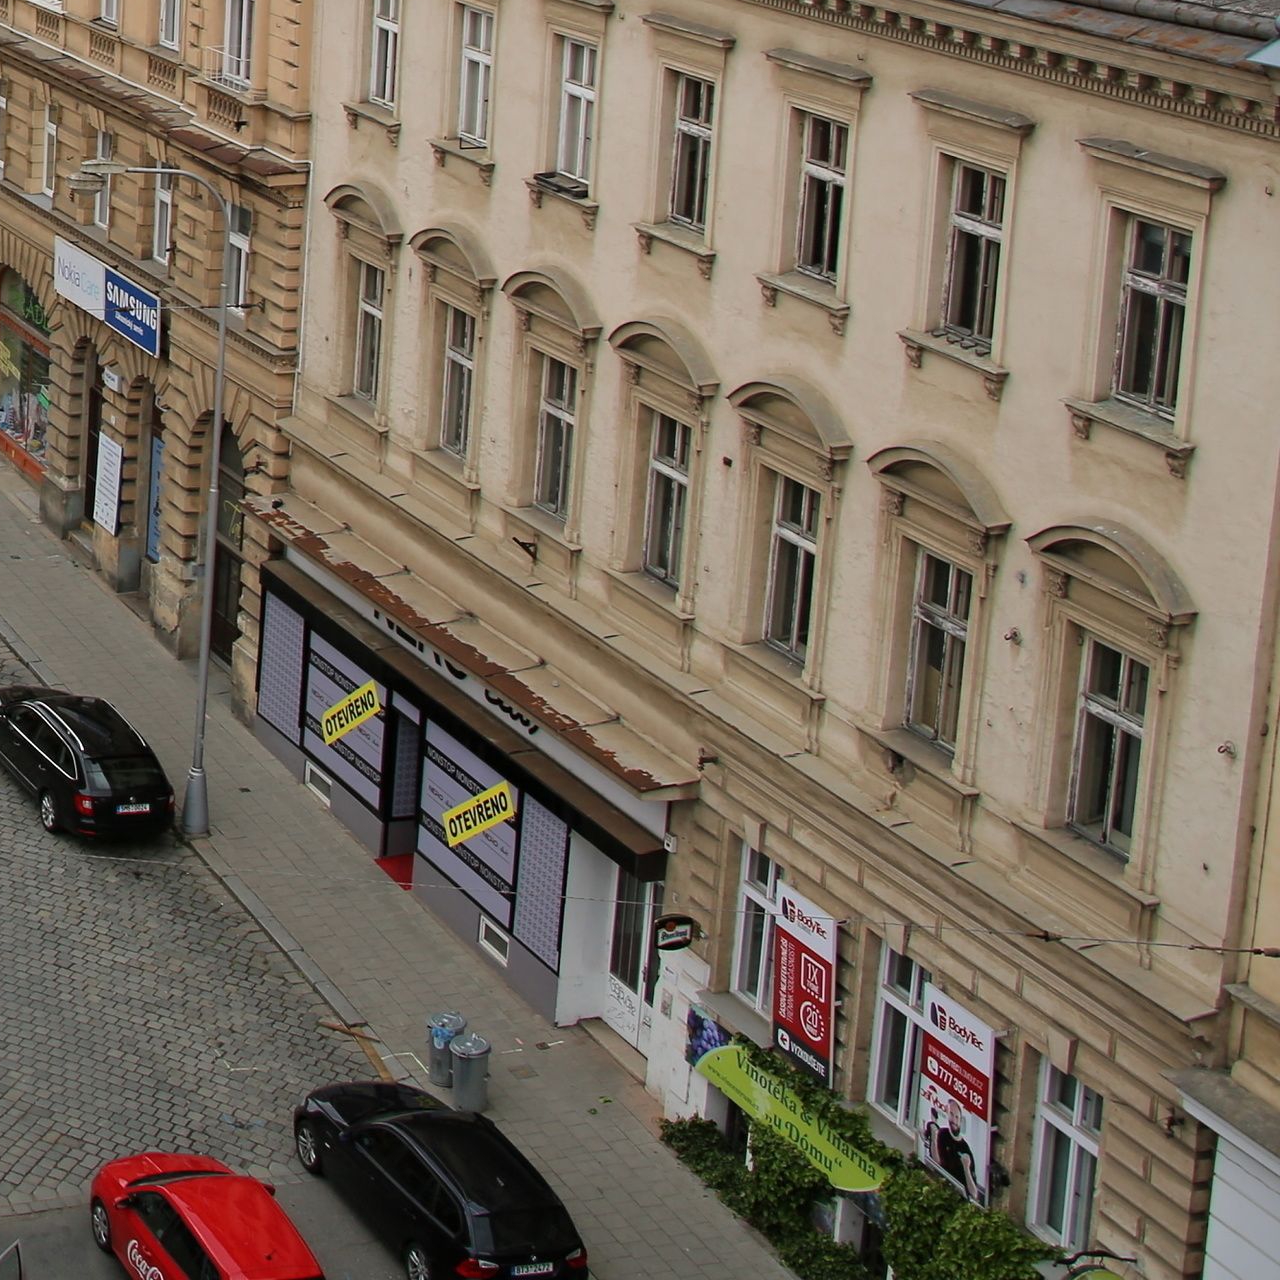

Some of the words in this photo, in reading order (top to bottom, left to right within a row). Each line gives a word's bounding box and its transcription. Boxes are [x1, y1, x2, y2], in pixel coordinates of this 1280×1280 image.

[58, 256, 80, 287] Nokia
[81, 272, 100, 300] Care
[106, 281, 157, 330] SAMSUNG
[325, 689, 375, 736] OTEVŘENO
[427, 745, 456, 774] NONSTOP
[448, 791, 508, 838] OTEVŘENO
[797, 907, 827, 940] BodyTec
[807, 963, 818, 985] 1X
[806, 1006, 818, 1028] 20
[948, 1015, 984, 1052] BodyTec
[736, 1051, 797, 1113] Vinotéka
[800, 1111, 812, 1126] &
[939, 1065, 952, 1086] 777
[953, 1078, 967, 1098] 352
[969, 1089, 983, 1110] 132
